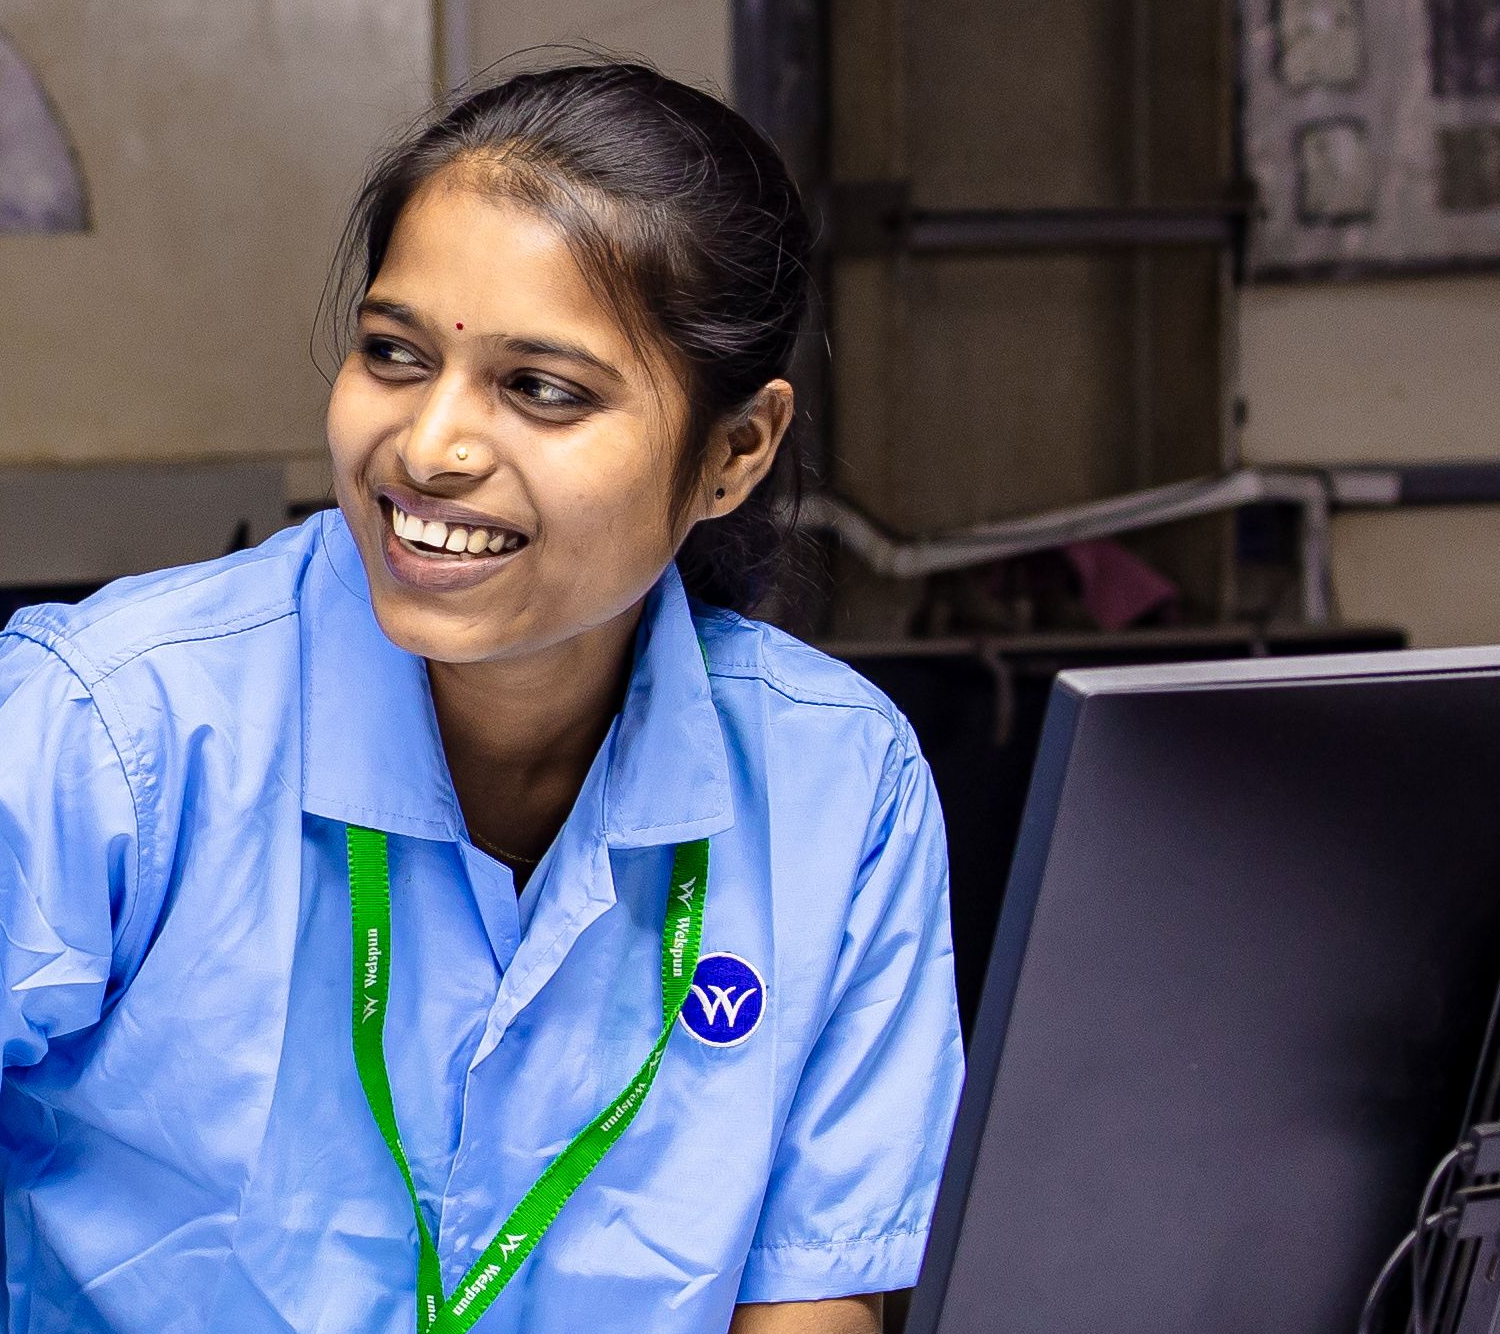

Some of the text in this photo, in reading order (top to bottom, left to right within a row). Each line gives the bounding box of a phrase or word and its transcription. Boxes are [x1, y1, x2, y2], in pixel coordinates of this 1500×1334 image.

[363, 928, 383, 989] Welspun
[669, 916, 691, 978] Welspun
[600, 1082, 648, 1133] Welspun
[451, 1263, 502, 1317] Welspun
